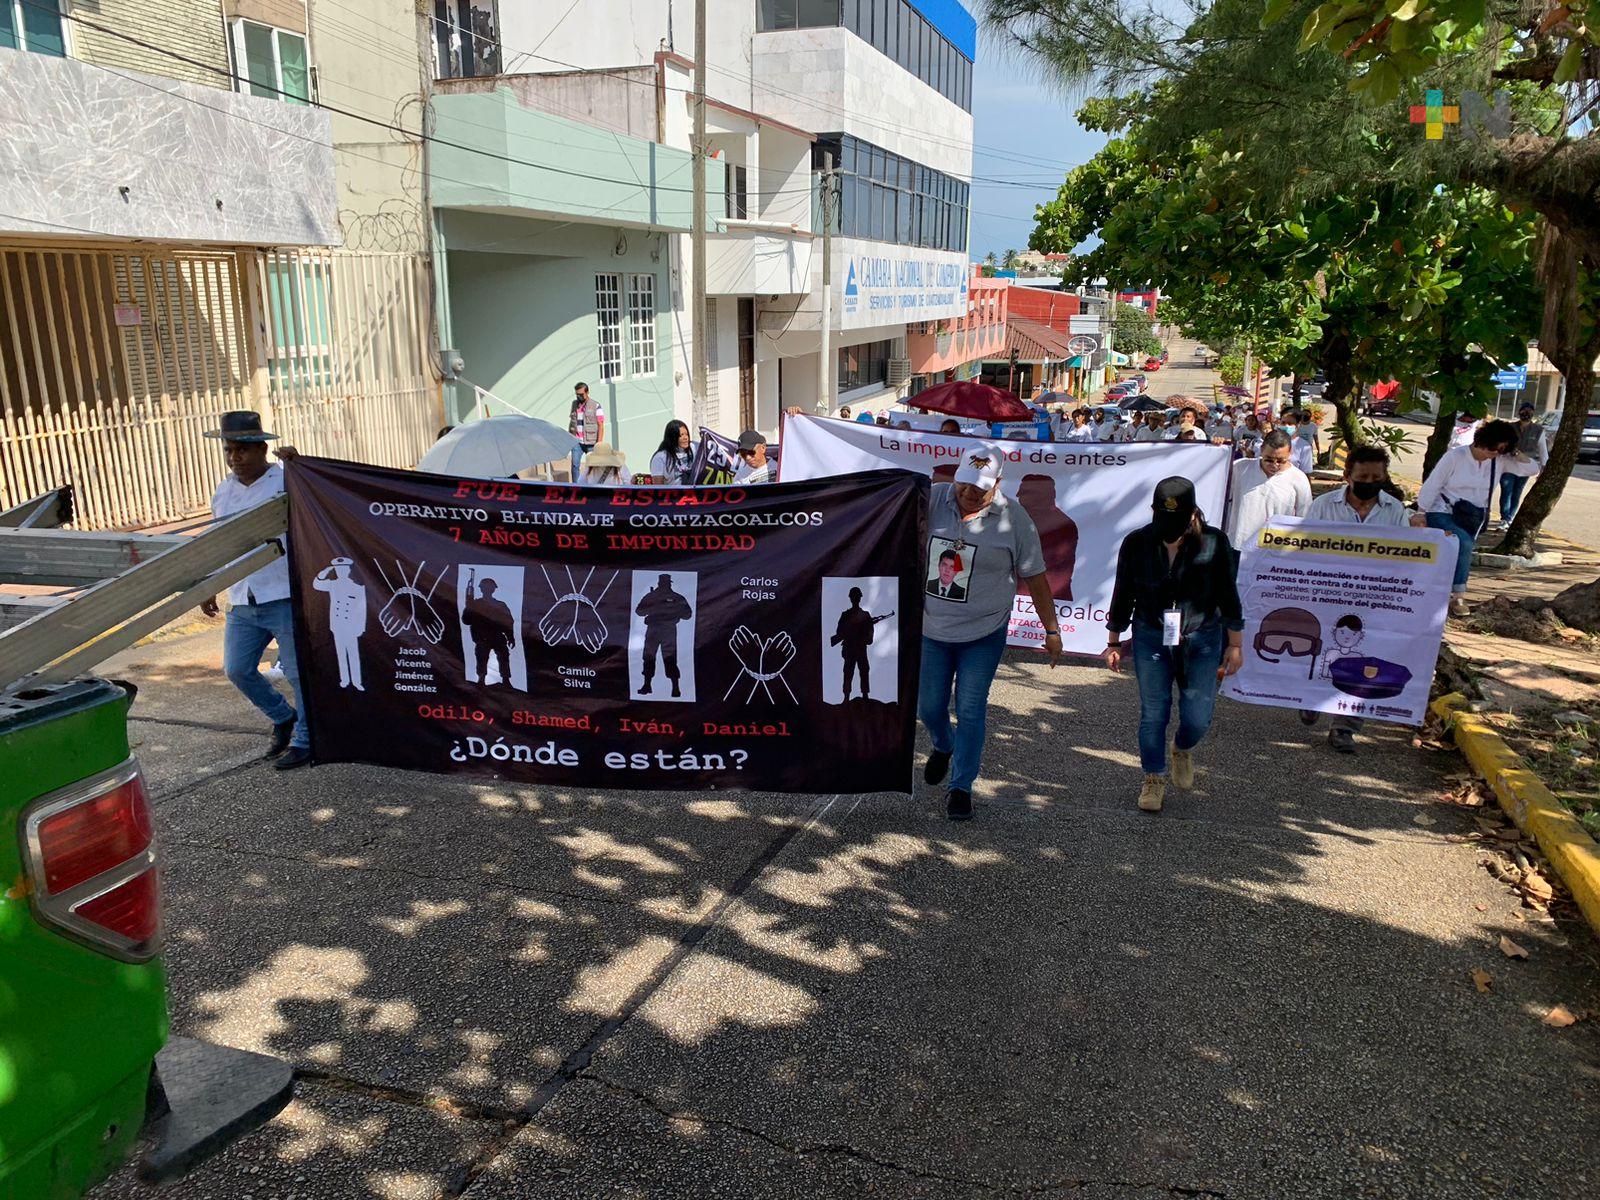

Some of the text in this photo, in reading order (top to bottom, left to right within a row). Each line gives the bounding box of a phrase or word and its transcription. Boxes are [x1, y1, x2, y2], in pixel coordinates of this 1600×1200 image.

[861, 257, 892, 288] CAMARA
[879, 434, 1127, 466] La impud de antes
[453, 481, 747, 506] FUE EL ESTADO
[369, 501, 823, 527] OPERATIVO BLINDAJE COATZACOALCOS
[449, 526, 756, 551] 7 AÑOS DE IMPUNIDAD
[1263, 533, 1431, 559] Desaparición Forzada
[740, 576, 779, 586] Carlos
[1270, 566, 1305, 577] Arresto,
[1307, 569, 1352, 580] detención
[1361, 574, 1400, 584] traslado
[1256, 573, 1297, 584] personas
[1311, 579, 1340, 588] contra
[1368, 584, 1408, 594] voluntad
[1410, 589, 1425, 597] por
[742, 589, 776, 602] Rojas
[1261, 591, 1310, 602] particulares
[1319, 597, 1353, 606] nombre
[1355, 600, 1369, 608] del
[1371, 602, 1414, 614] gobierno.
[1312, 588, 1342, 598] grupos
[1343, 591, 1395, 602] organizados
[1022, 631, 1045, 641] 2015
[398, 647, 427, 656] Jacob
[395, 659, 431, 669] Vicente
[557, 665, 596, 677] Camilo
[395, 670, 434, 681] Jiménez
[564, 678, 591, 689] Silva
[394, 682, 437, 693] González
[418, 704, 791, 737] Odilo, Shamed, Iván, Daniel
[450, 736, 748, 770] ¿Dónde están?
